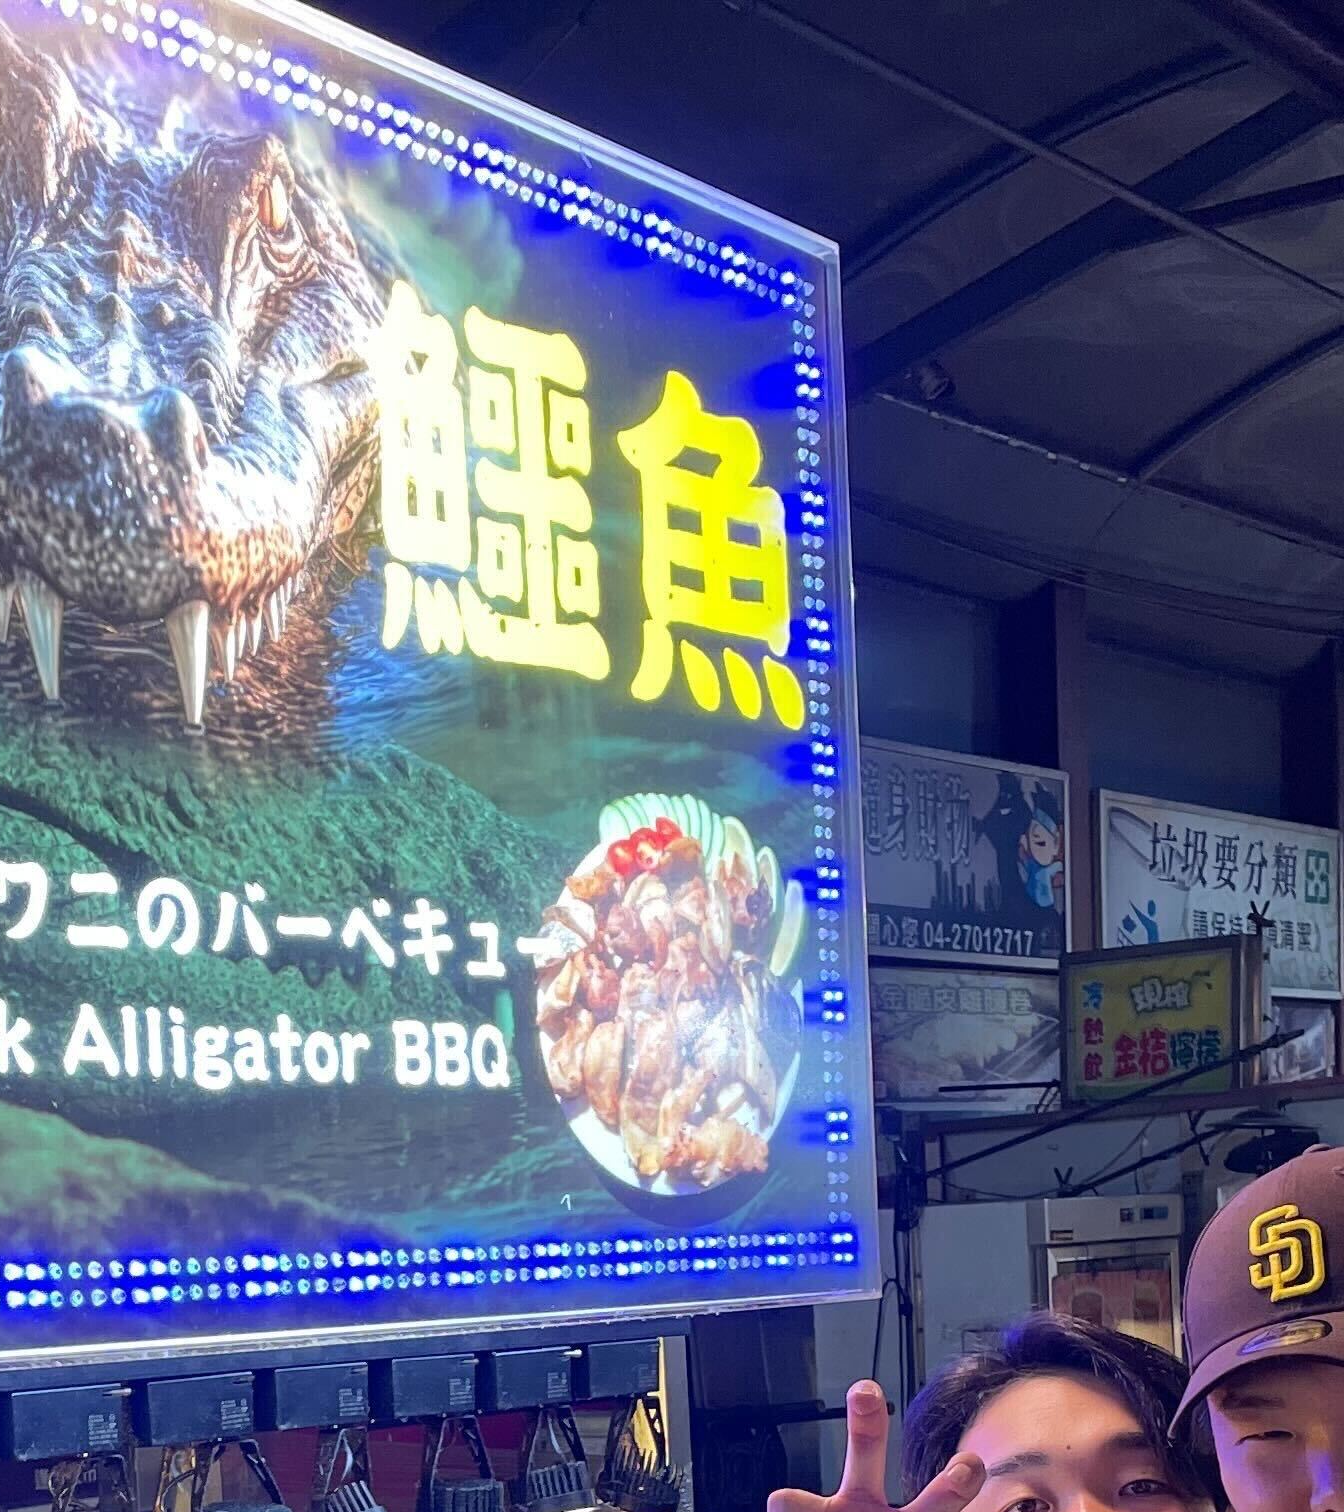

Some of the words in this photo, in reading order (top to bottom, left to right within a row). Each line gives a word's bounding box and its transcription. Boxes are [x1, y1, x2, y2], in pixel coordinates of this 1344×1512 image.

[364, 280, 807, 730] 鱷魚
[1149, 821, 1299, 899] 垃圾要分類
[923, 920, 1034, 956] 04-27012717
[62, 1006, 370, 1089] Alligator
[393, 1017, 512, 1091] BBQ
[1249, 1204, 1325, 1303] SD
